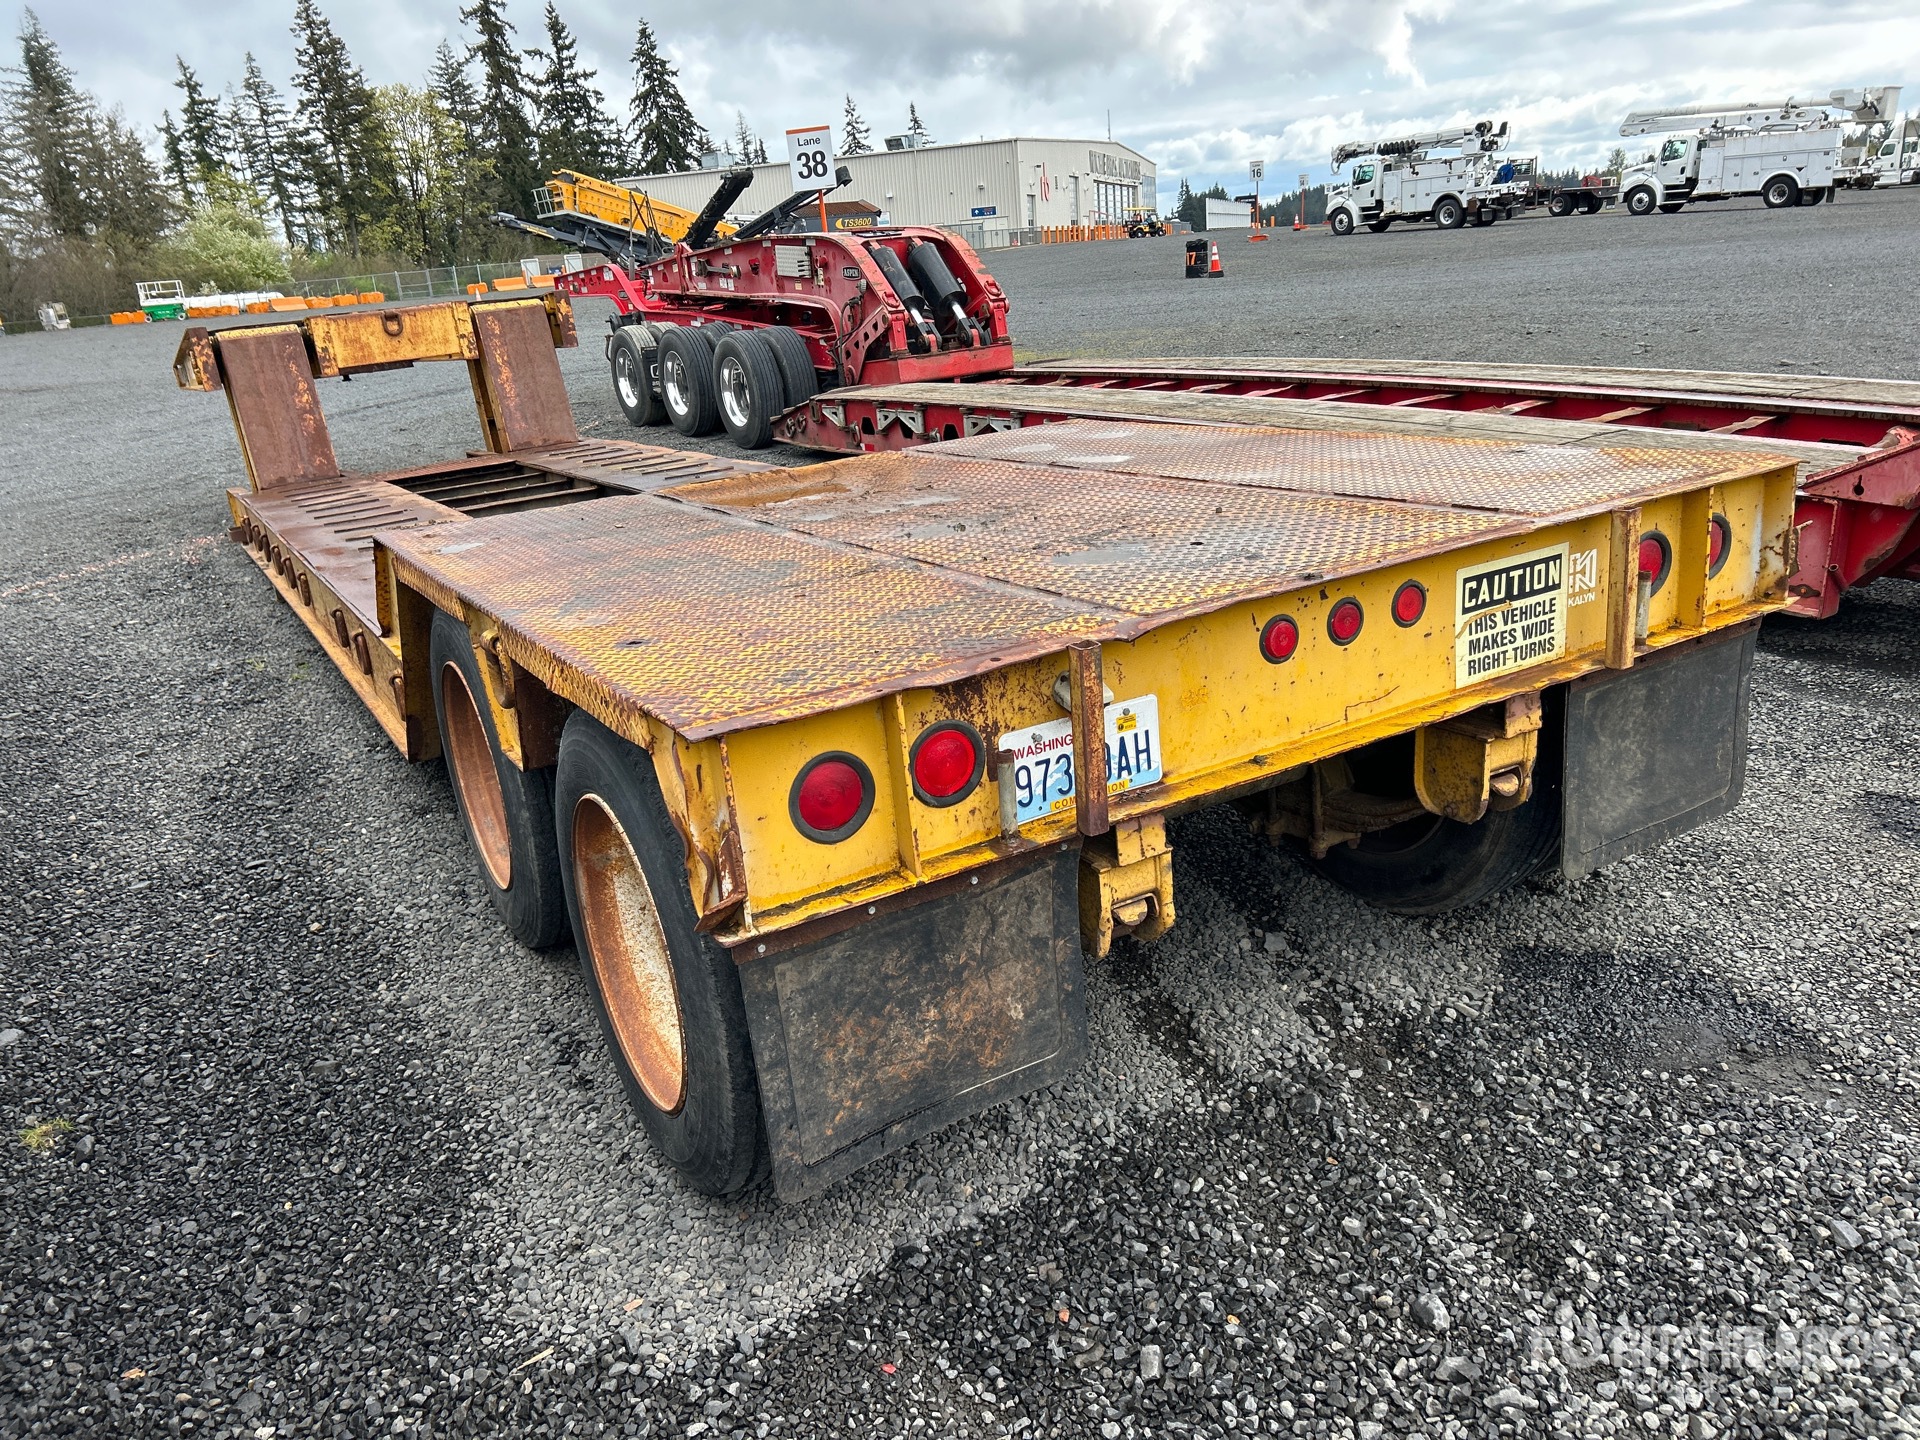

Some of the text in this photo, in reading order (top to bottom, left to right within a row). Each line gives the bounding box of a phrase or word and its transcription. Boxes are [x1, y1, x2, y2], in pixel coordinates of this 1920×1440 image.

[797, 137, 821, 147] Lane
[796, 150, 828, 180] 38
[1251, 168, 1262, 178] 16
[844, 217, 872, 227] TS3600
[843, 268, 859, 277] ASPEN
[1464, 558, 1561, 609] CAUTION
[1568, 591, 1596, 608] KALYN
[1468, 597, 1557, 637] THIS VEHICLE
[1468, 616, 1556, 656] MAKES WIDE
[1467, 636, 1555, 677] RIGHT TURNS
[1013, 733, 1074, 761] WASHING
